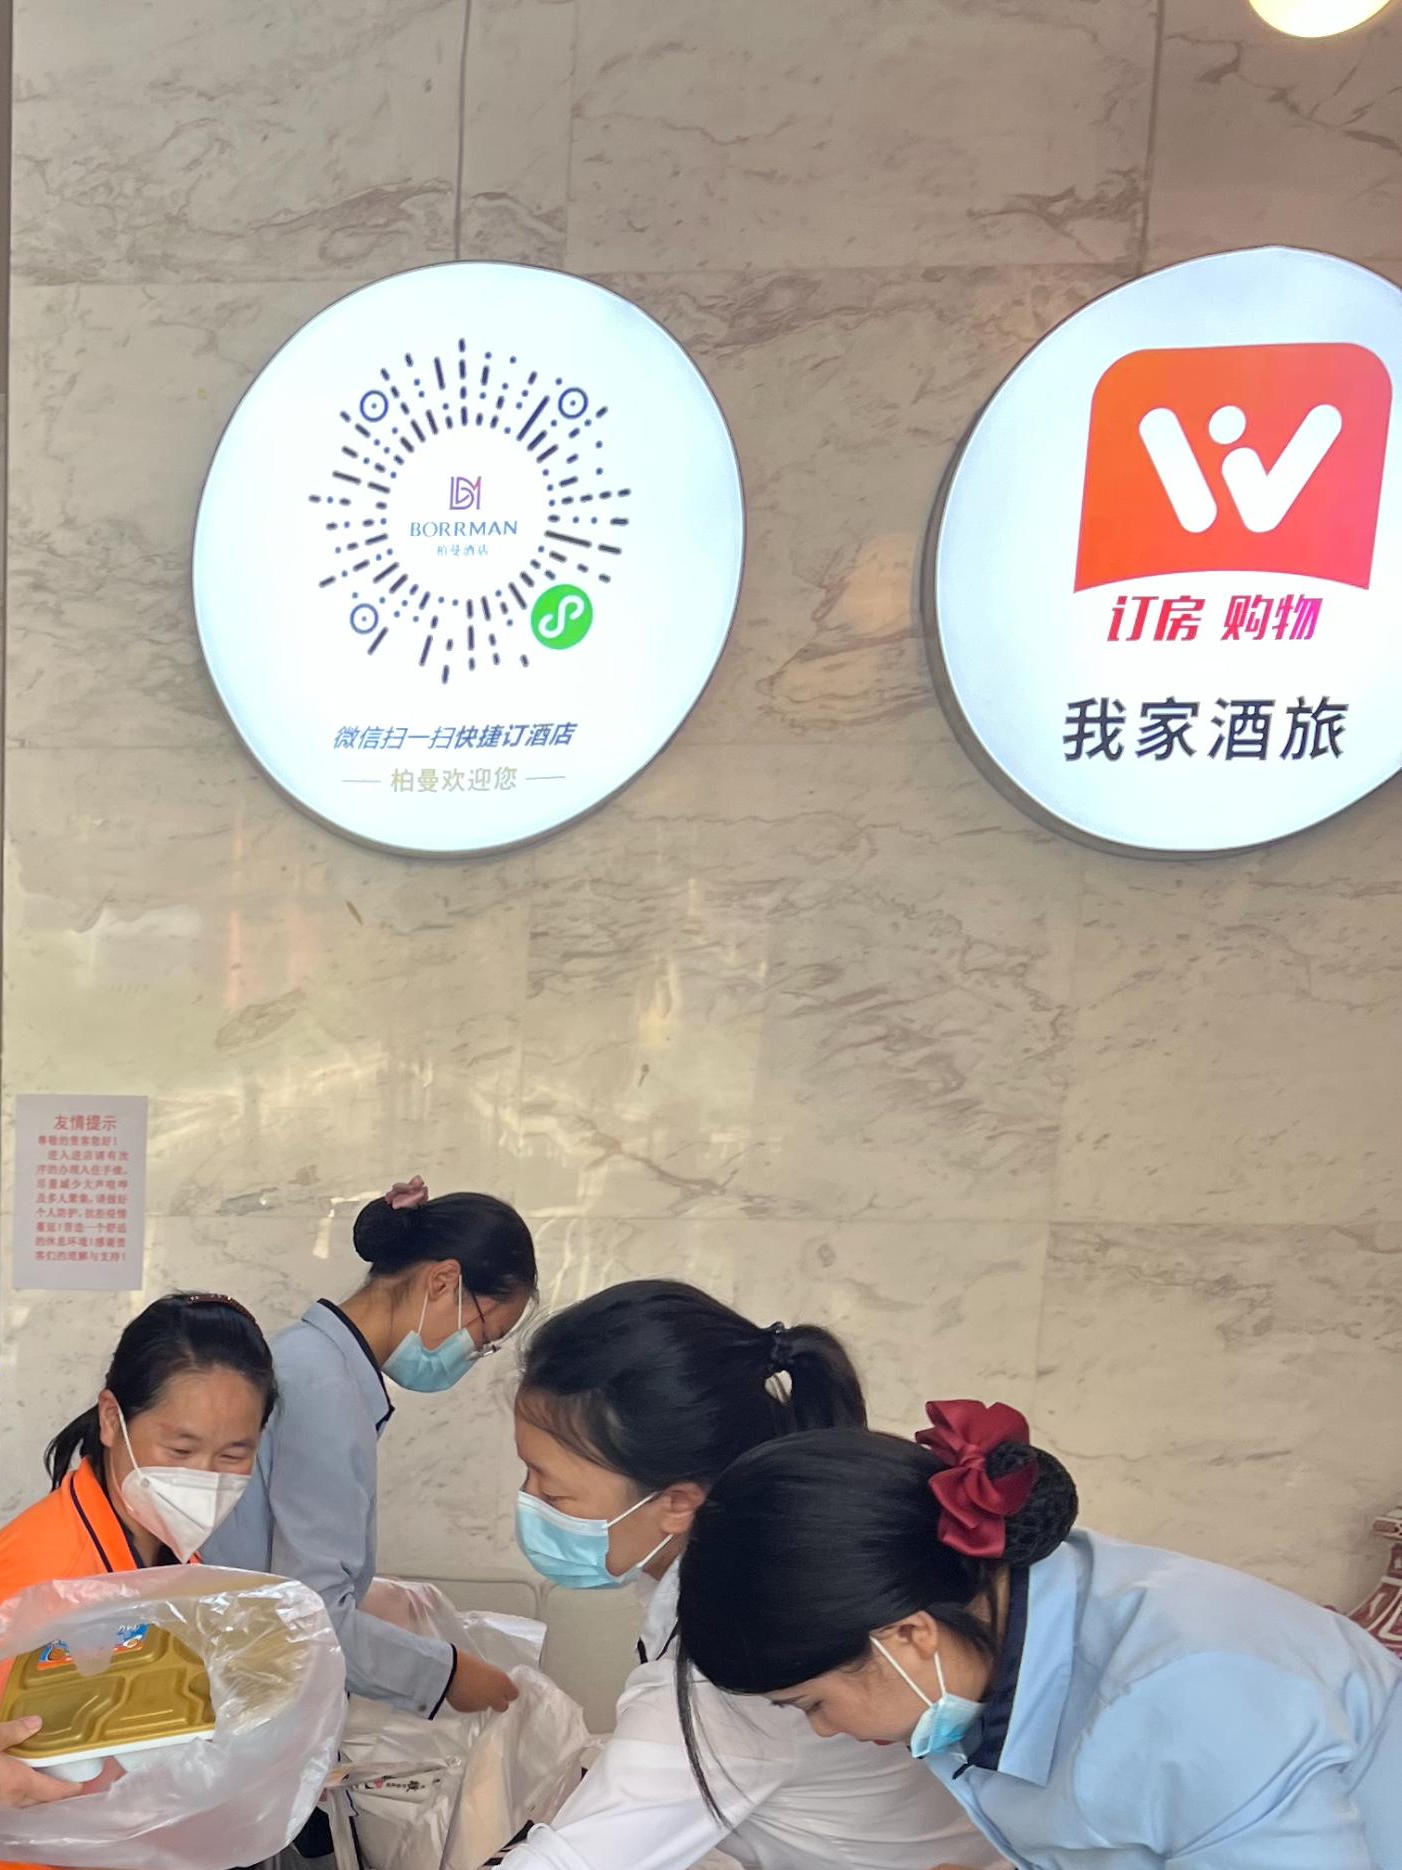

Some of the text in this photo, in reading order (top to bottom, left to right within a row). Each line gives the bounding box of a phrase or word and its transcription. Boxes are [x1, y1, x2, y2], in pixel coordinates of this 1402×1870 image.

[410, 520, 518, 537] BORRMAN
[1107, 594, 1323, 642] 订房 购物
[333, 722, 578, 750] 微信扫一扫快捷订酒店
[1062, 696, 1350, 762] 我家酒旅
[390, 766, 517, 793] 柏曼欢迎您
[54, 1114, 117, 1131] 友情提示
